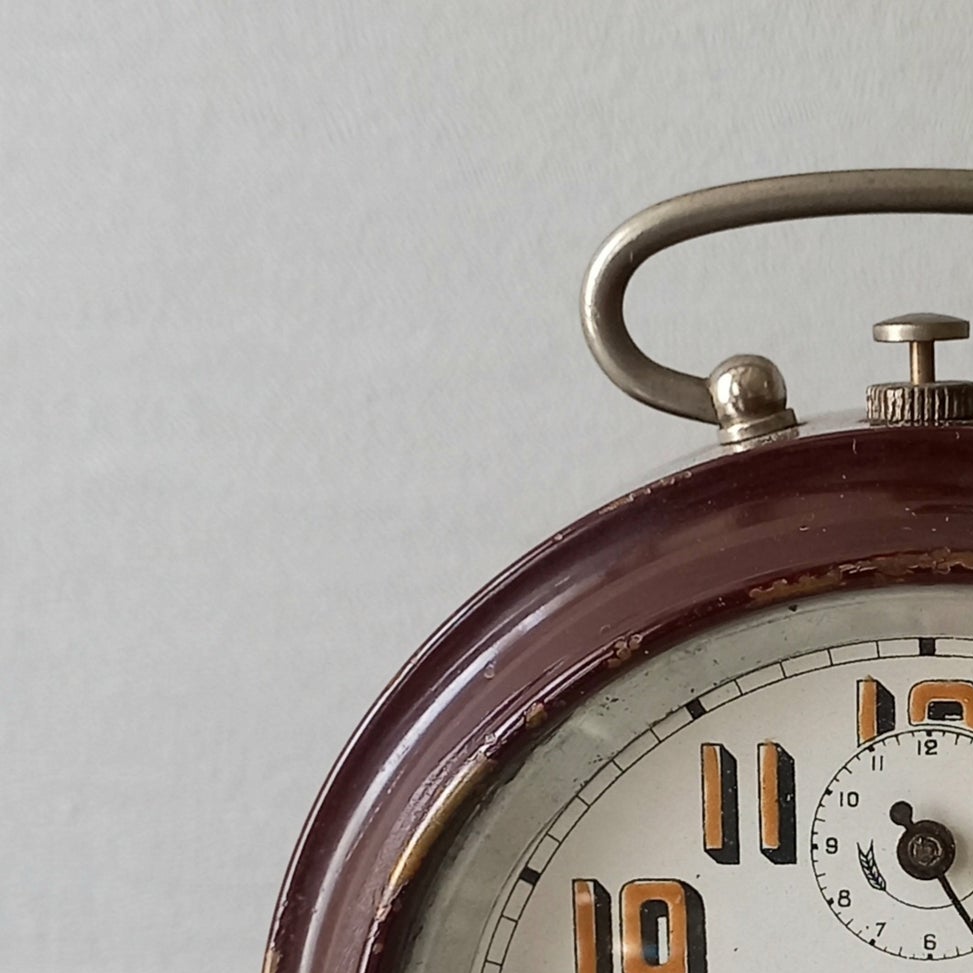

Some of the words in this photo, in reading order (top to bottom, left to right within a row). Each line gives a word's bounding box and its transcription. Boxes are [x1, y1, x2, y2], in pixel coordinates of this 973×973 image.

[917, 739, 938, 756] 12
[871, 756, 884, 771] 11
[700, 742, 797, 865] 11
[839, 791, 859, 807] 10
[825, 837, 838, 854] 9
[837, 890, 851, 907] 8
[874, 922, 886, 938] 7
[923, 934, 937, 950] 6
